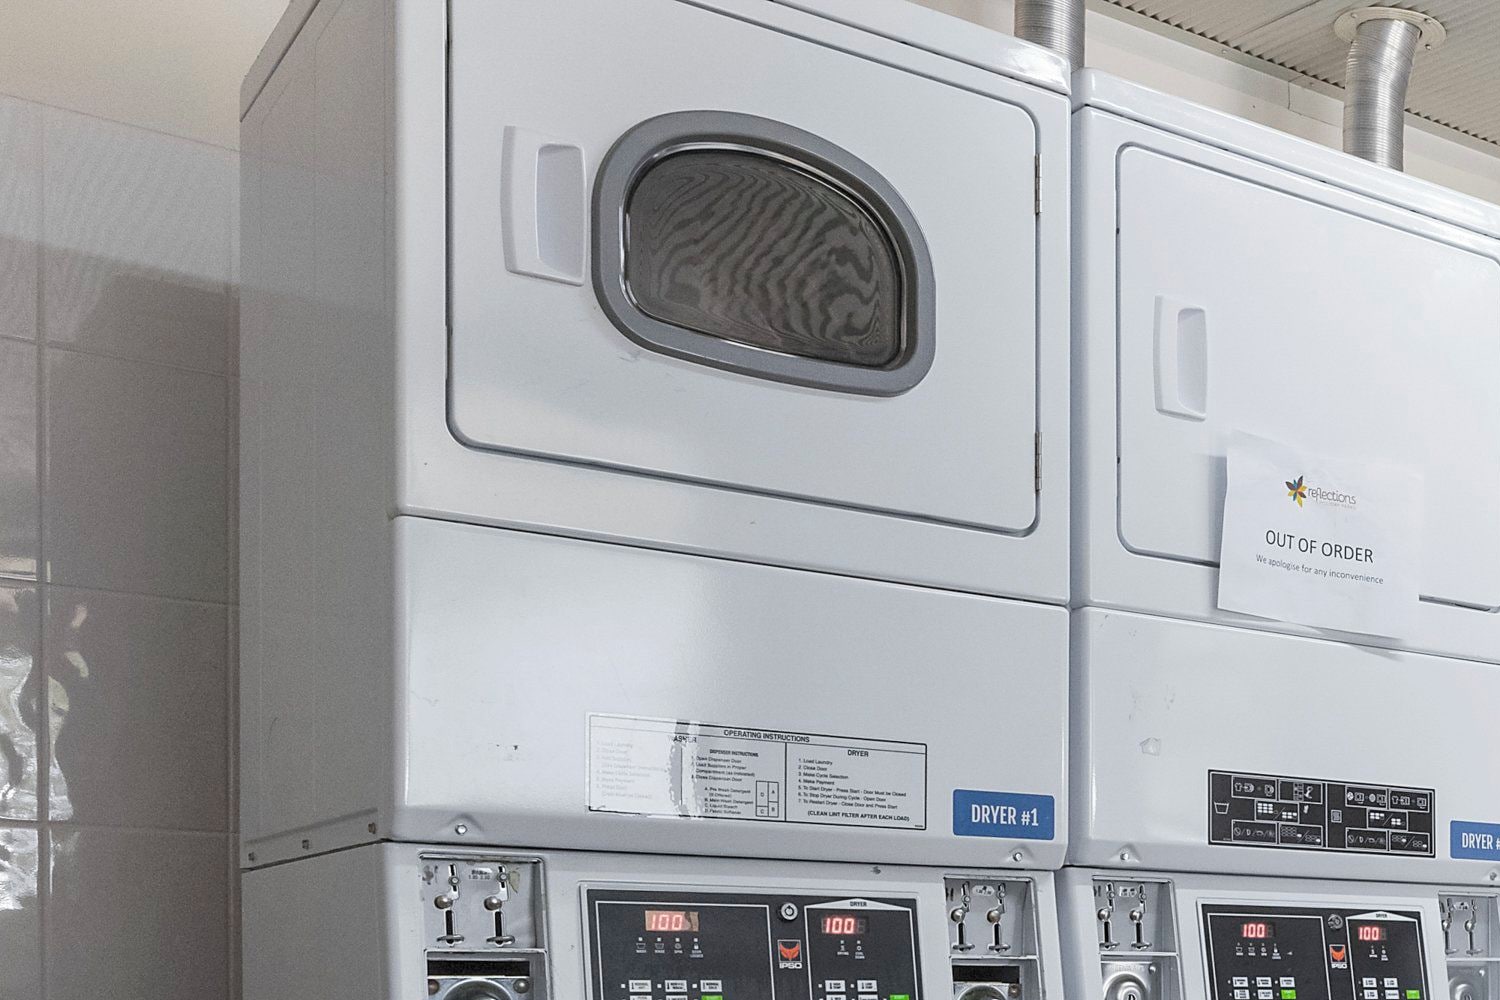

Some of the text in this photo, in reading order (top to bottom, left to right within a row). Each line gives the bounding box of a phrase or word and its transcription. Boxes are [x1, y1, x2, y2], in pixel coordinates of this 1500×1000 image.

[1308, 487, 1356, 504] reflections
[1266, 530, 1374, 563] OUT OF ORDER
[1256, 554, 1384, 584] We apologise for any inconvenience
[724, 730, 810, 743] OPERATING INSTRUCTIONS
[972, 804, 1039, 826] DRYER #1
[1462, 832, 1493, 850] DRYER
[652, 914, 683, 930] 100
[825, 918, 854, 934] 100
[1243, 924, 1265, 938] 100
[1359, 927, 1379, 940] 100
